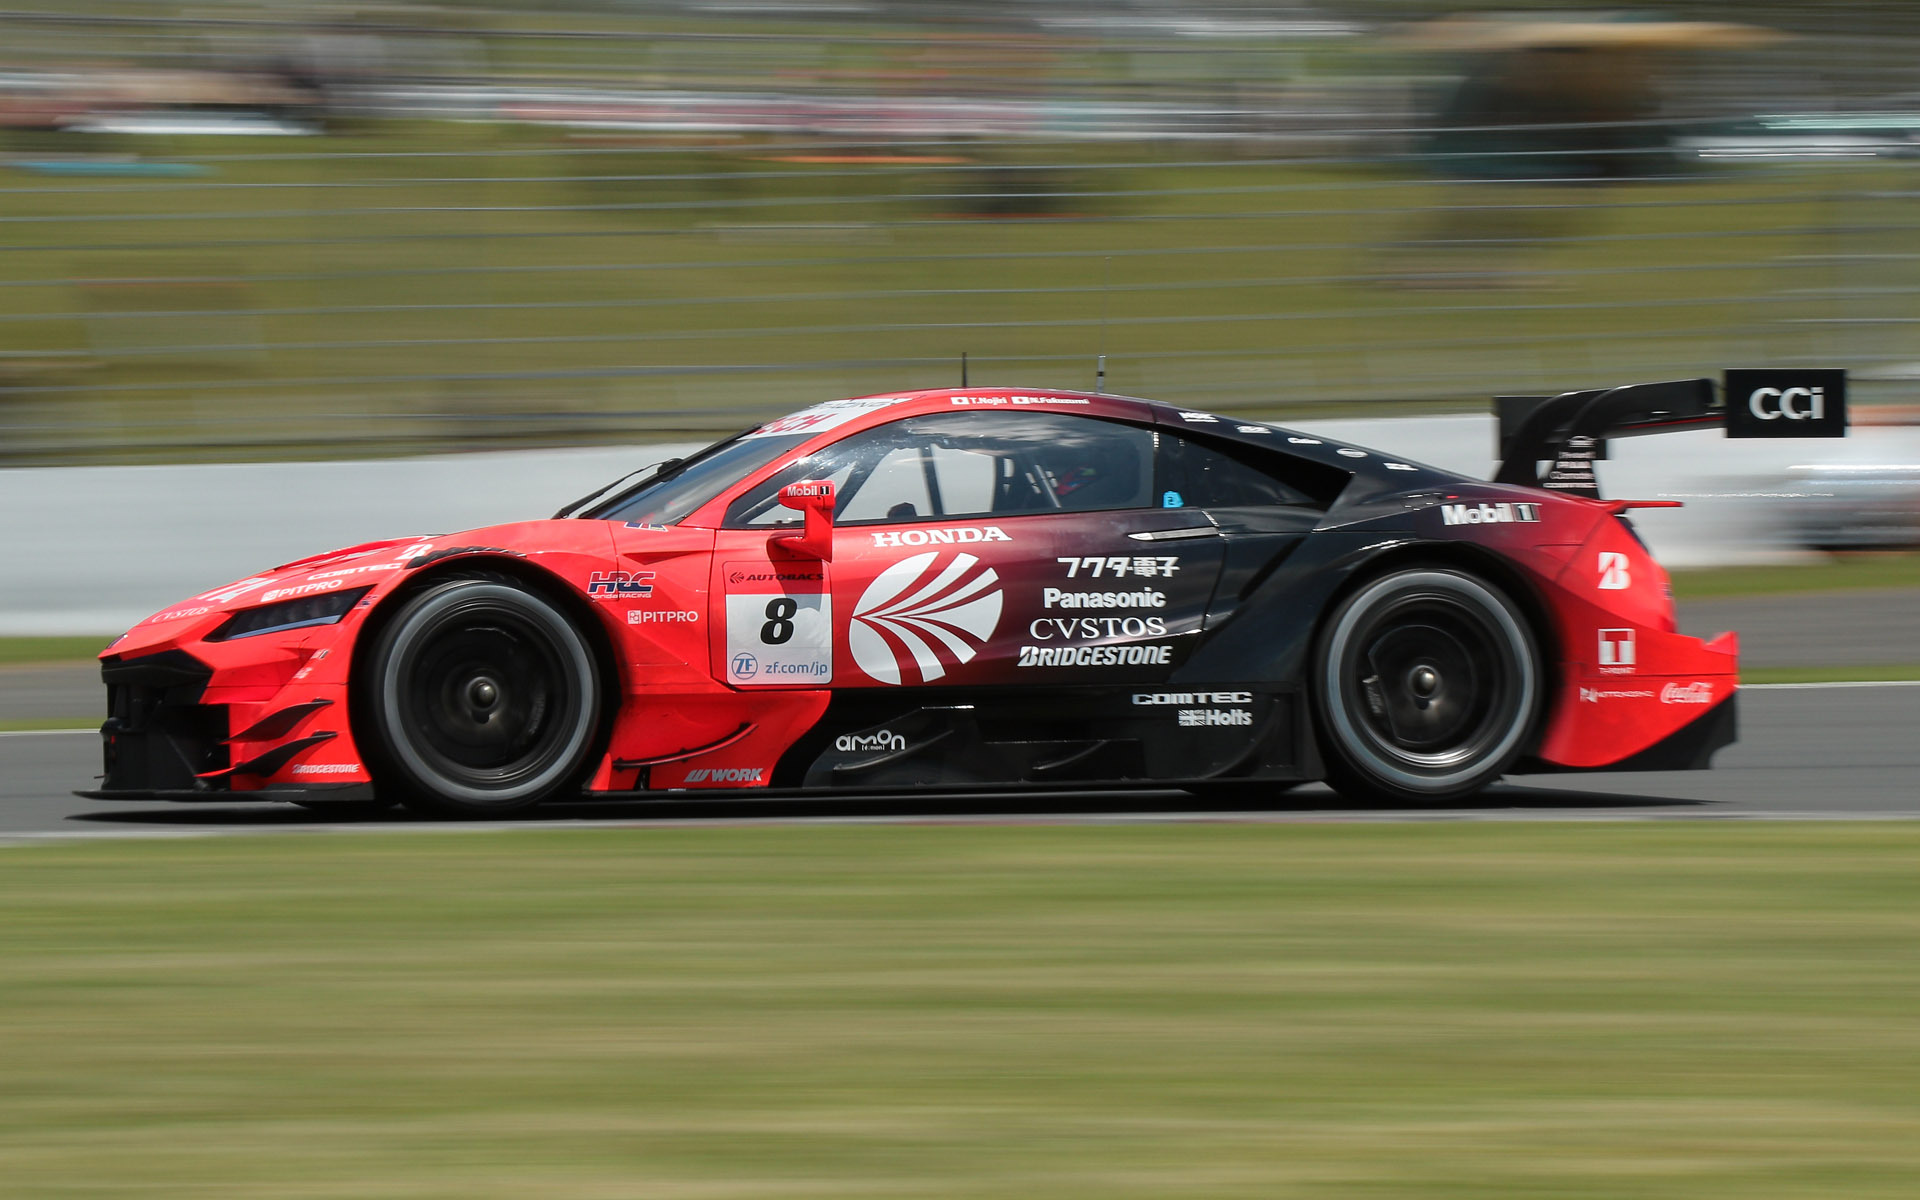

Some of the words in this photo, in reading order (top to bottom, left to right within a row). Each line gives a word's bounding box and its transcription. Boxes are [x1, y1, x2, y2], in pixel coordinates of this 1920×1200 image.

[1749, 387, 1825, 420] CCi
[787, 485, 818, 497] Mobil
[1441, 503, 1514, 526] Mobil
[1518, 504, 1535, 521] 1
[871, 526, 1012, 547] HONDA
[587, 571, 656, 594] HRC
[746, 573, 825, 582] AUTOBACS
[278, 580, 343, 598] PITPRO
[1043, 587, 1167, 609] Panasonic
[643, 611, 699, 622] PITPRO
[760, 598, 798, 645] 8
[1029, 617, 1168, 640] CVSTOS
[734, 656, 753, 675] ZF
[1017, 645, 1173, 667] BRIDGESTONE
[765, 661, 828, 676] zf.com/jp
[1132, 692, 1252, 705] COMTEC
[1206, 709, 1252, 725] Holts
[835, 729, 905, 751] amon
[711, 768, 764, 782] WORK
